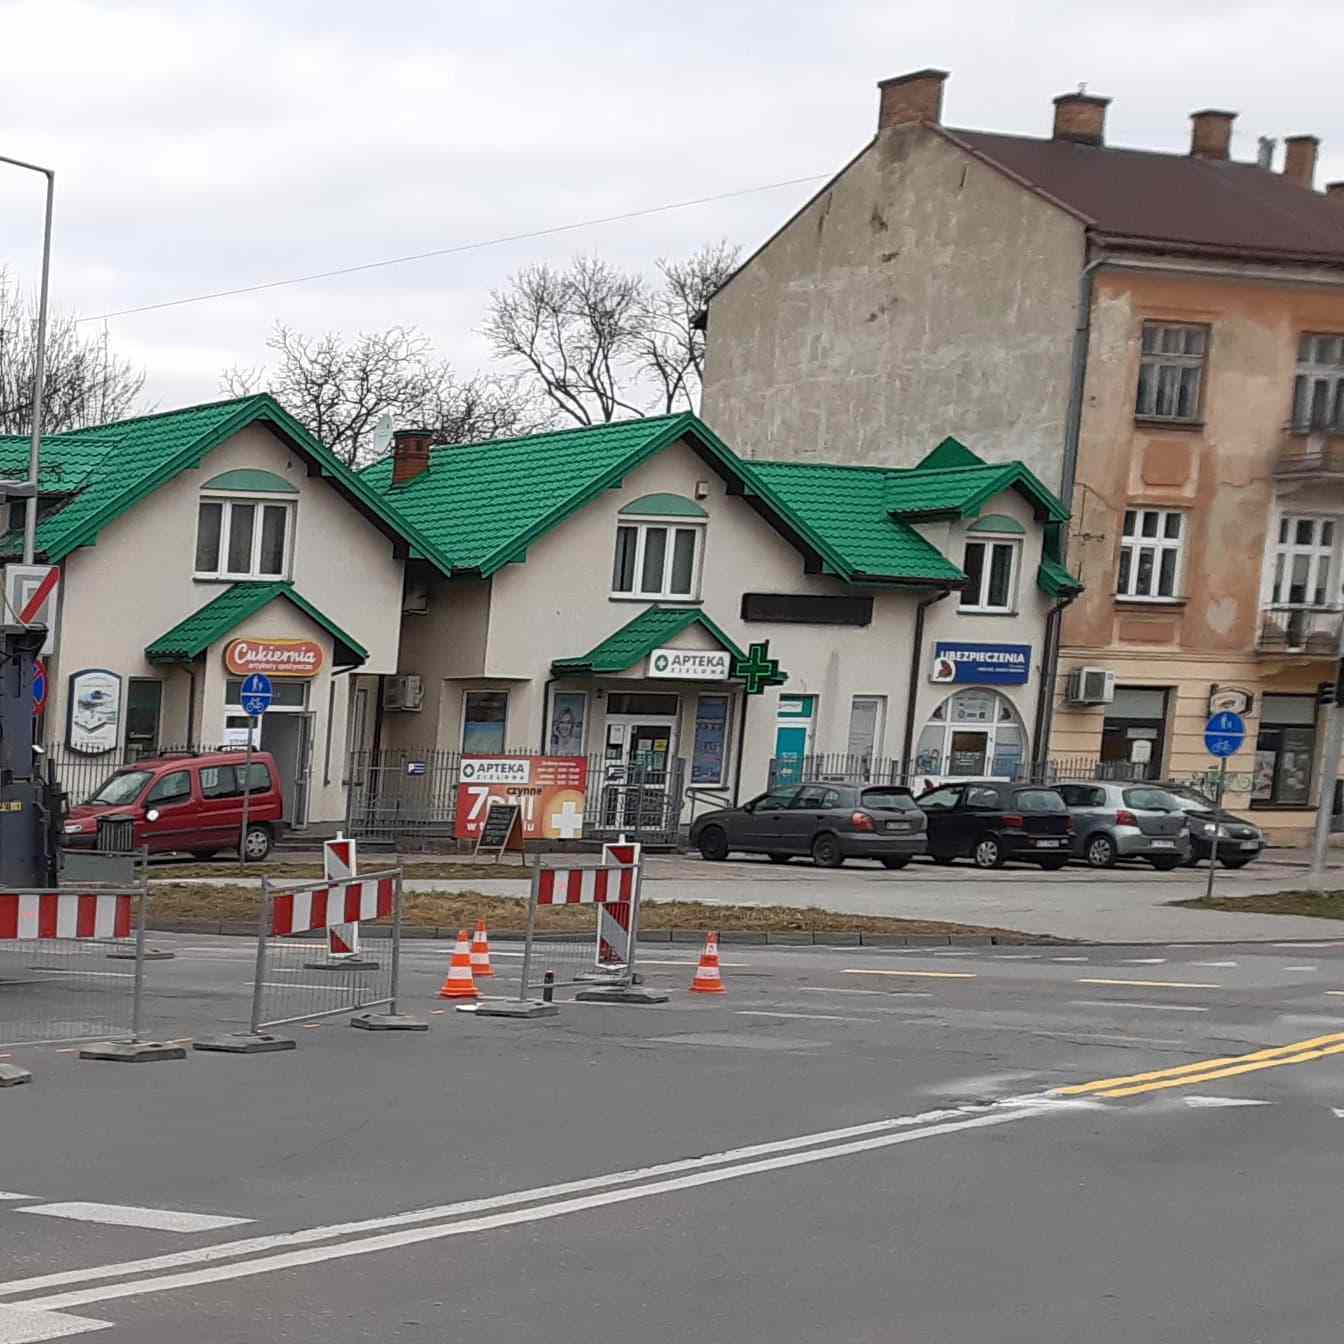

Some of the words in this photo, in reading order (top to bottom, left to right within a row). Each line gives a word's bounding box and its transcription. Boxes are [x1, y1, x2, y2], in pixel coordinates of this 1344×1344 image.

[234, 643, 316, 664] Cukiernia
[672, 655, 725, 667] APTEKA
[476, 763, 525, 773] APTEKA
[506, 787, 543, 797] czynne
[467, 786, 489, 820] 7
